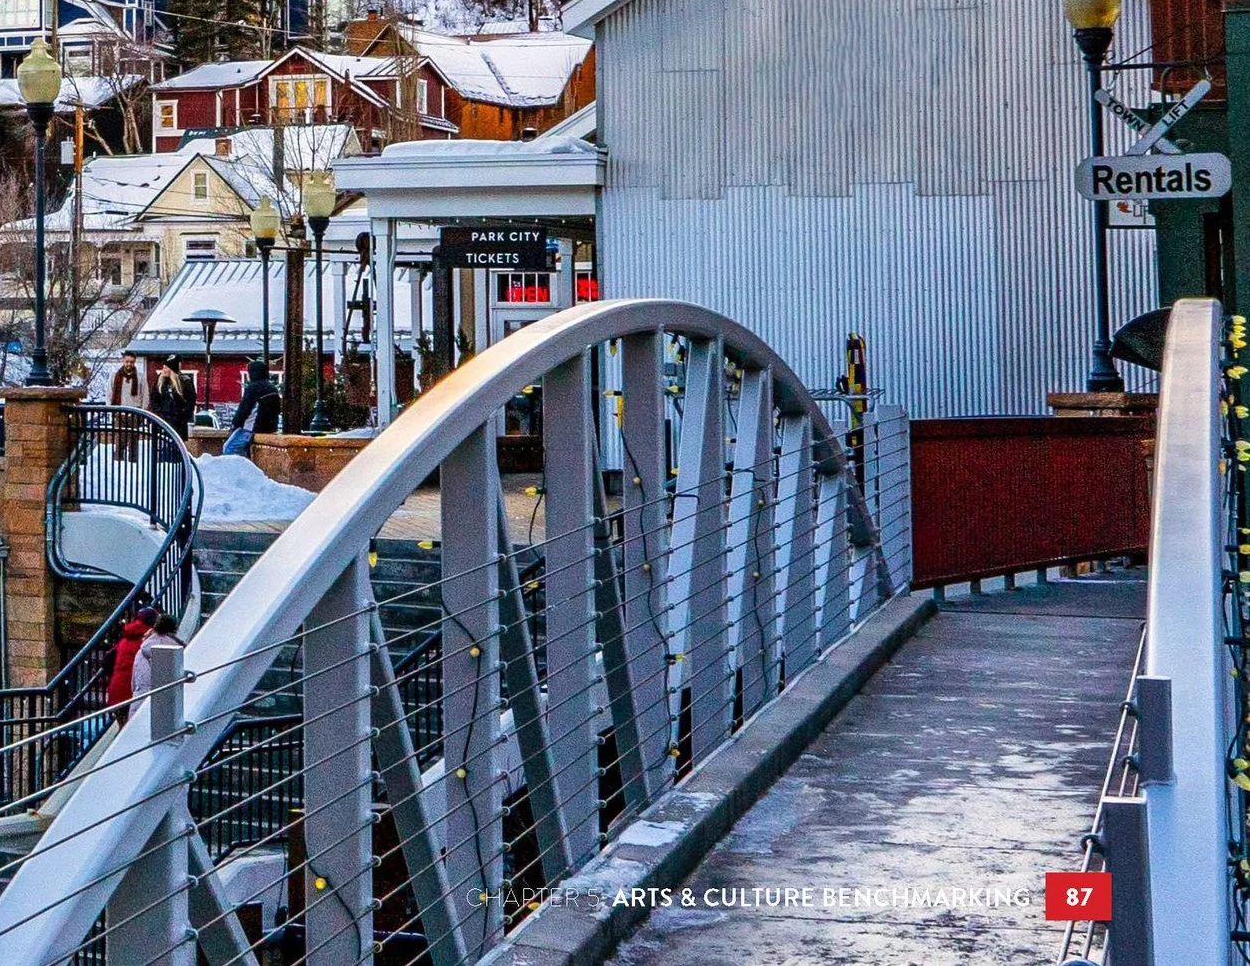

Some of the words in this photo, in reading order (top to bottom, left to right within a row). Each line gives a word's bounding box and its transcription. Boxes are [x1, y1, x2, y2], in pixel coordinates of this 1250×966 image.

[1106, 98, 1146, 132] TOWN
[1162, 100, 1190, 127] LIFT
[1092, 162, 1211, 195] Rentals
[471, 232, 505, 242] PARK
[509, 232, 540, 242] CITY
[466, 253, 519, 264] TICKETS
[505, 286, 549, 303] OPEN
